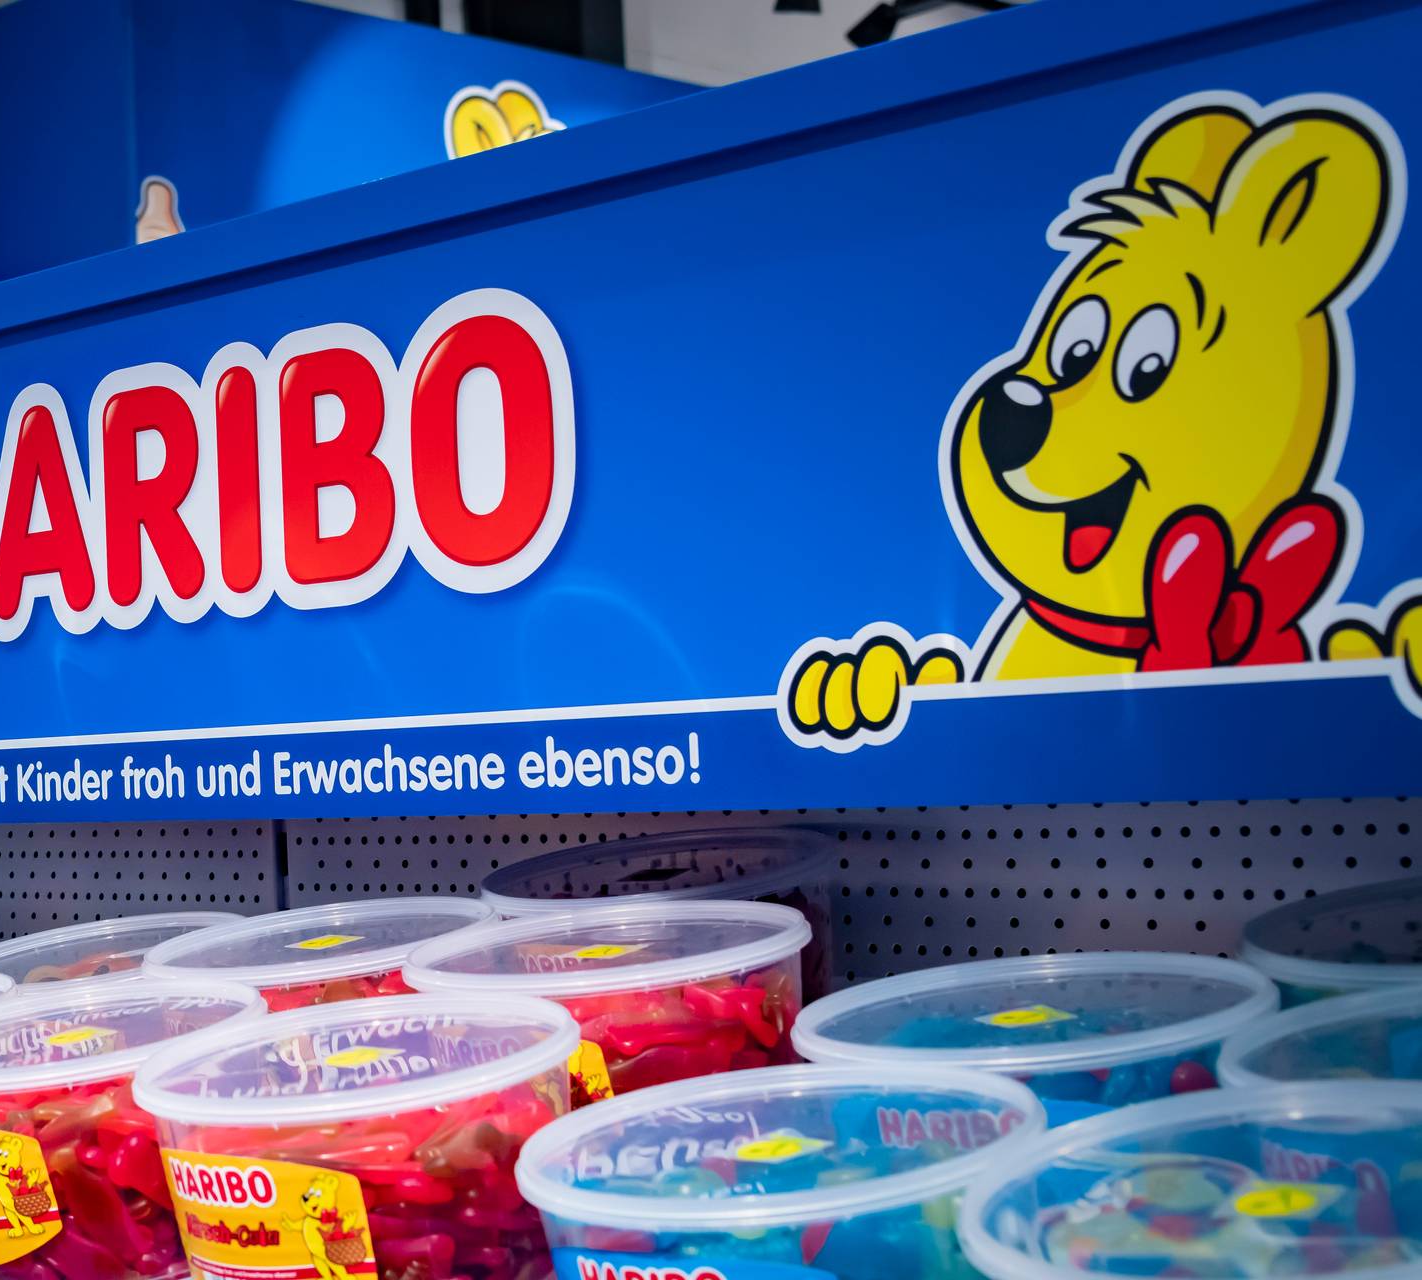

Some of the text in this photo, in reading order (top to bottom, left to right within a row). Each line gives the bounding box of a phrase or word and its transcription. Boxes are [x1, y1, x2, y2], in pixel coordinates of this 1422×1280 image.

[16, 757, 113, 803] Kinder
[121, 753, 186, 800] froh
[195, 749, 261, 797] und
[273, 743, 506, 795] Erwachsene
[518, 731, 701, 788] ebenso!
[170, 1160, 275, 1207] HARIBO
